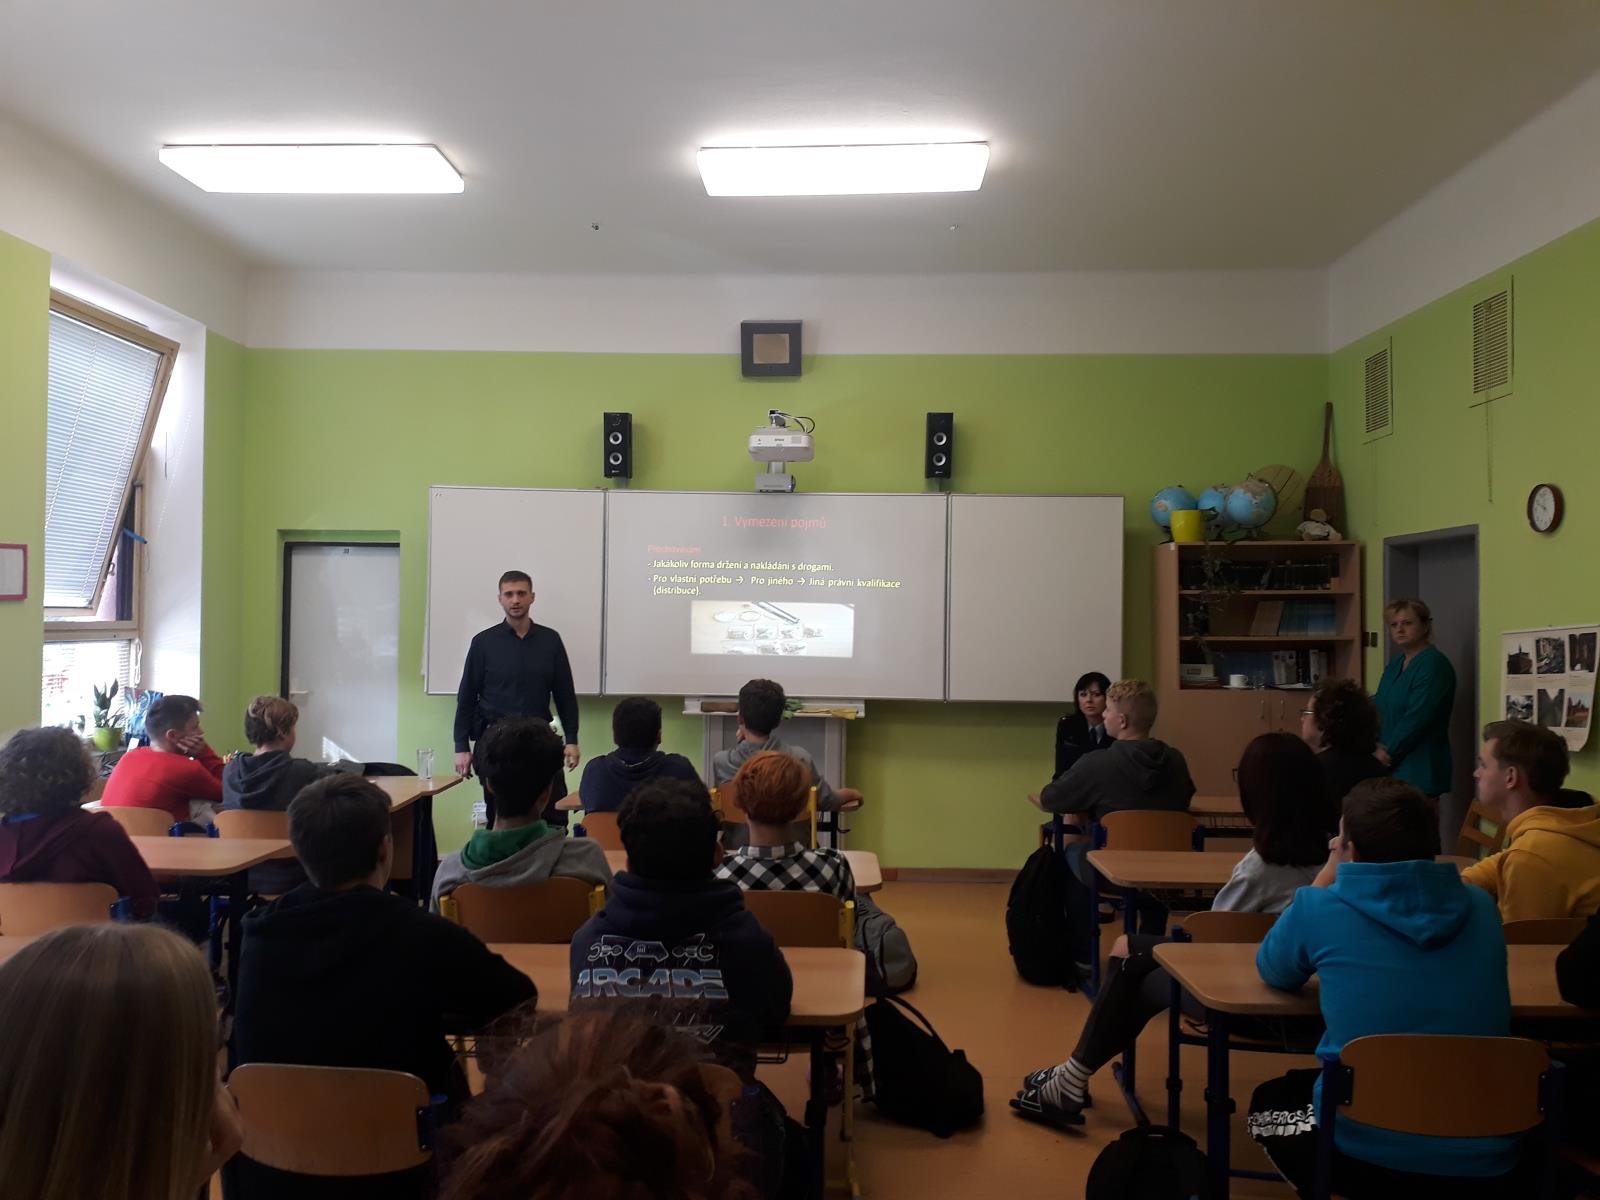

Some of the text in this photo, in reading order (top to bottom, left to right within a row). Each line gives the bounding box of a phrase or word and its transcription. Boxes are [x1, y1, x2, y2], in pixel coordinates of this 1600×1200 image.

[653, 559, 689, 568] Jakákoliv
[690, 560, 715, 569] forma
[716, 560, 742, 569] držení
[750, 561, 790, 571] nakládání
[797, 562, 834, 572] drogami.
[653, 574, 901, 588] Pro vlastní potřebu Pro jiného Jiná právní kvalifikace
[653, 586, 702, 596] (distribuce).
[572, 968, 729, 1000] ARCADE
